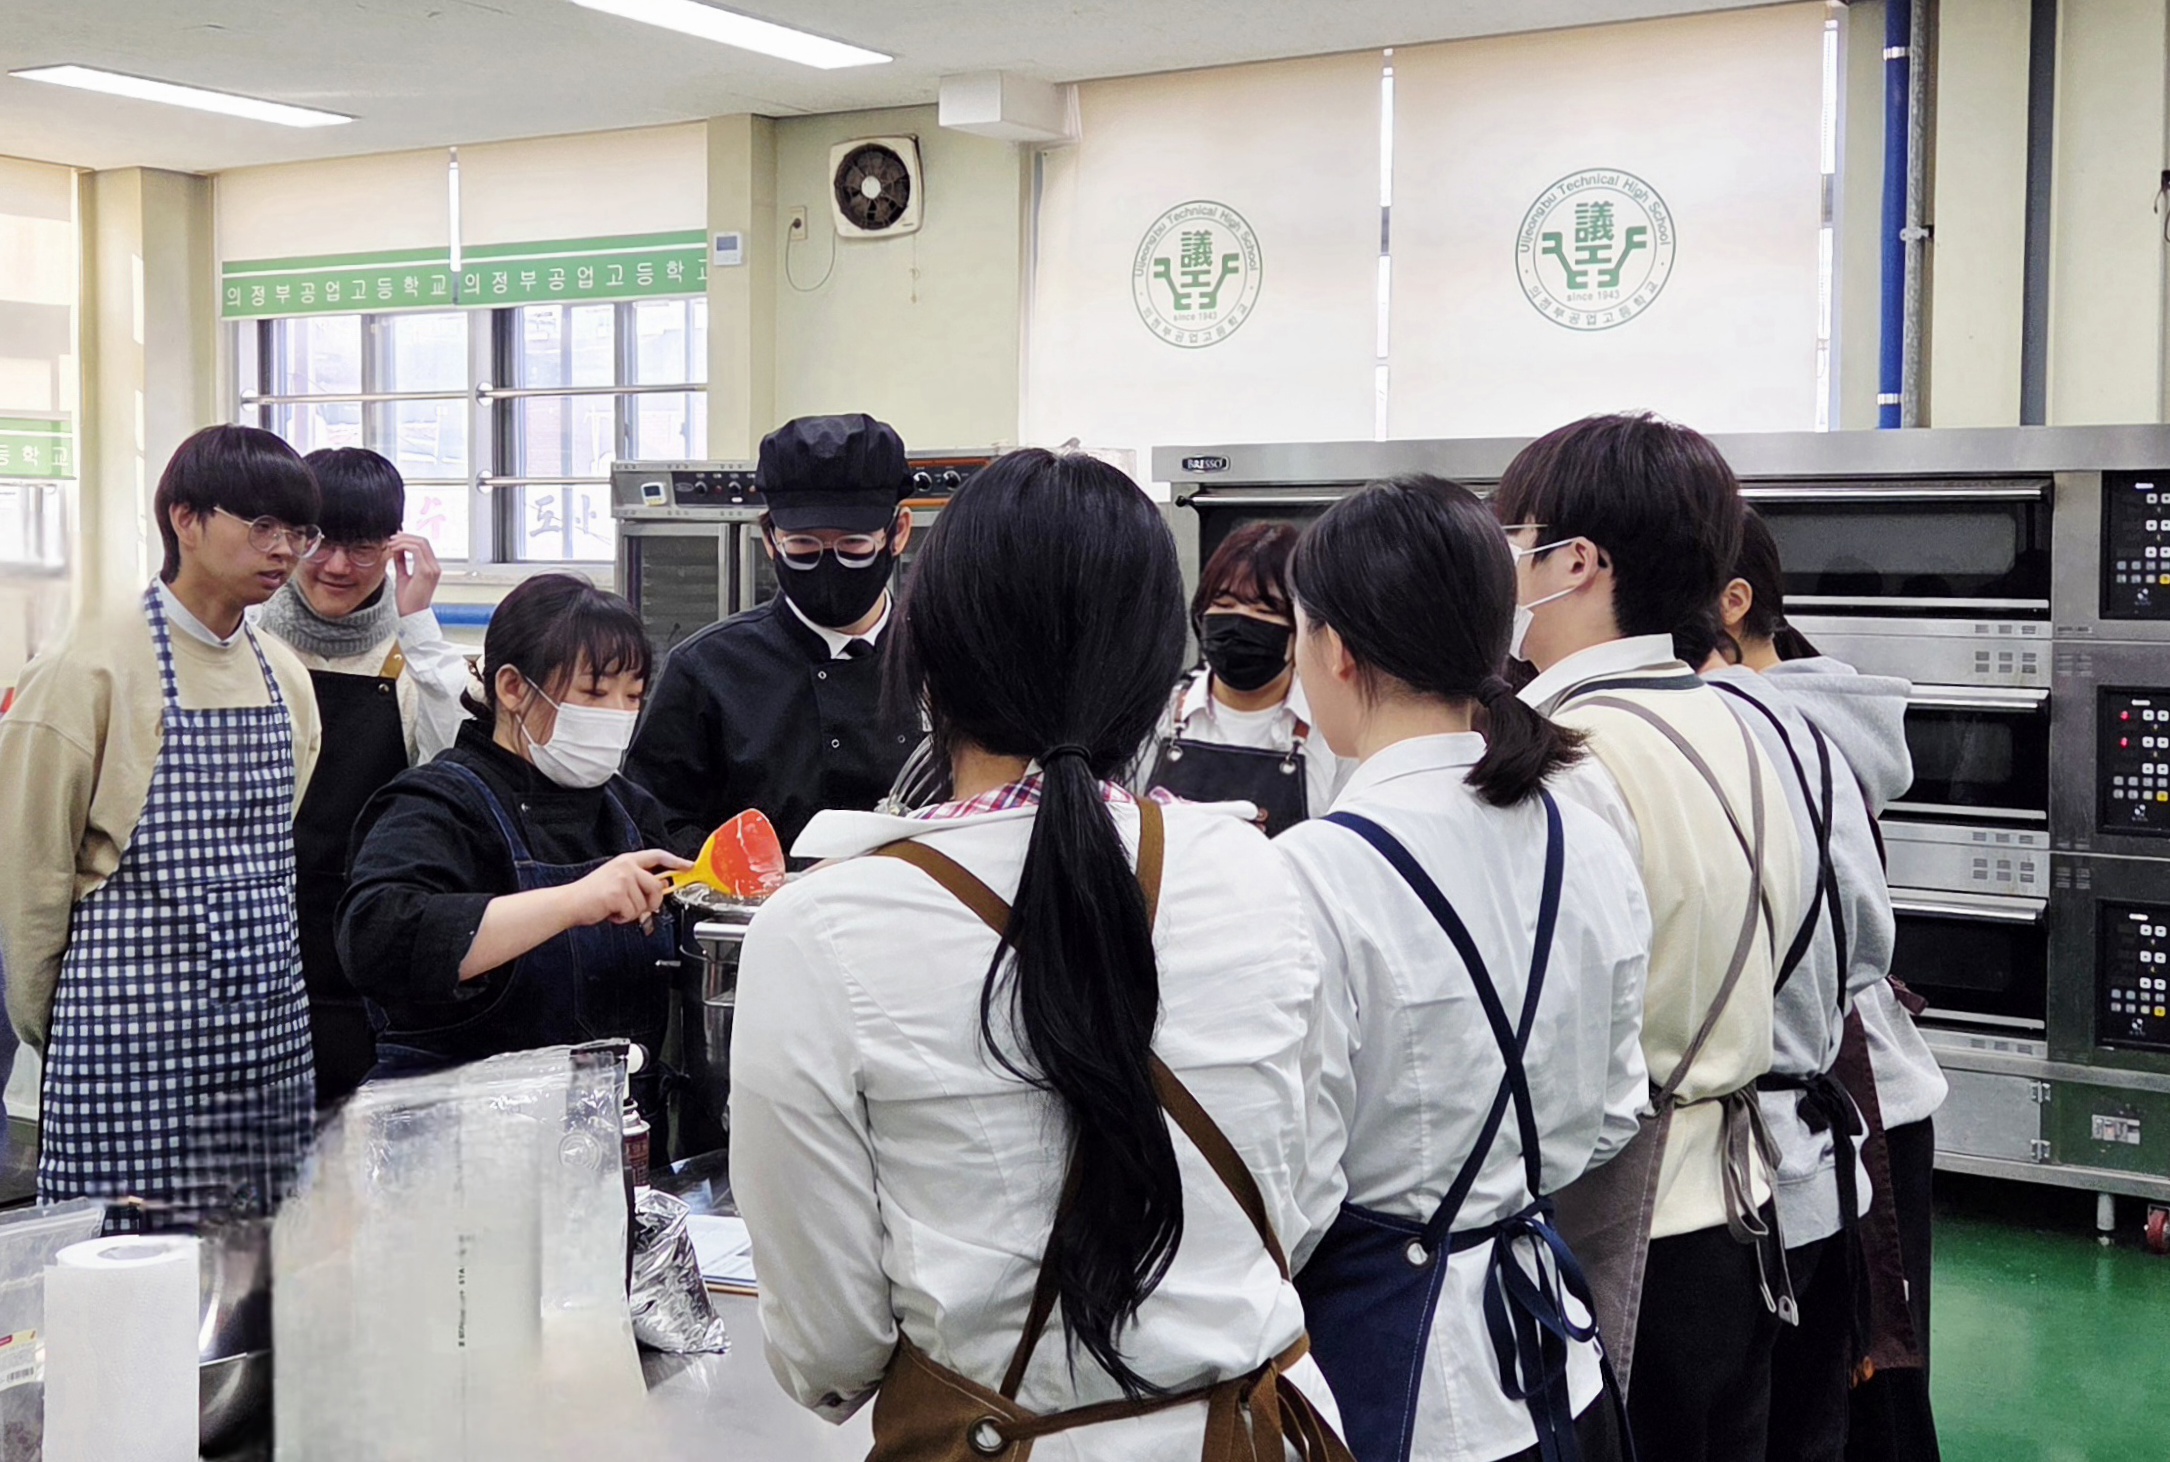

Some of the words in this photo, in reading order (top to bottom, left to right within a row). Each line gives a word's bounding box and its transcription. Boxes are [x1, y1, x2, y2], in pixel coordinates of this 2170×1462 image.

[1520, 192, 1557, 253] Uijeongbu
[1557, 173, 1619, 195] Technical
[1622, 178, 1650, 203] High
[1648, 201, 1671, 246] School
[1167, 205, 1217, 225] Technical
[1220, 210, 1242, 232] High
[1240, 231, 1258, 271] School
[226, 274, 447, 307] 의정부공업고등학교
[1567, 292, 1593, 302] since
[1597, 290, 1620, 300] 1943
